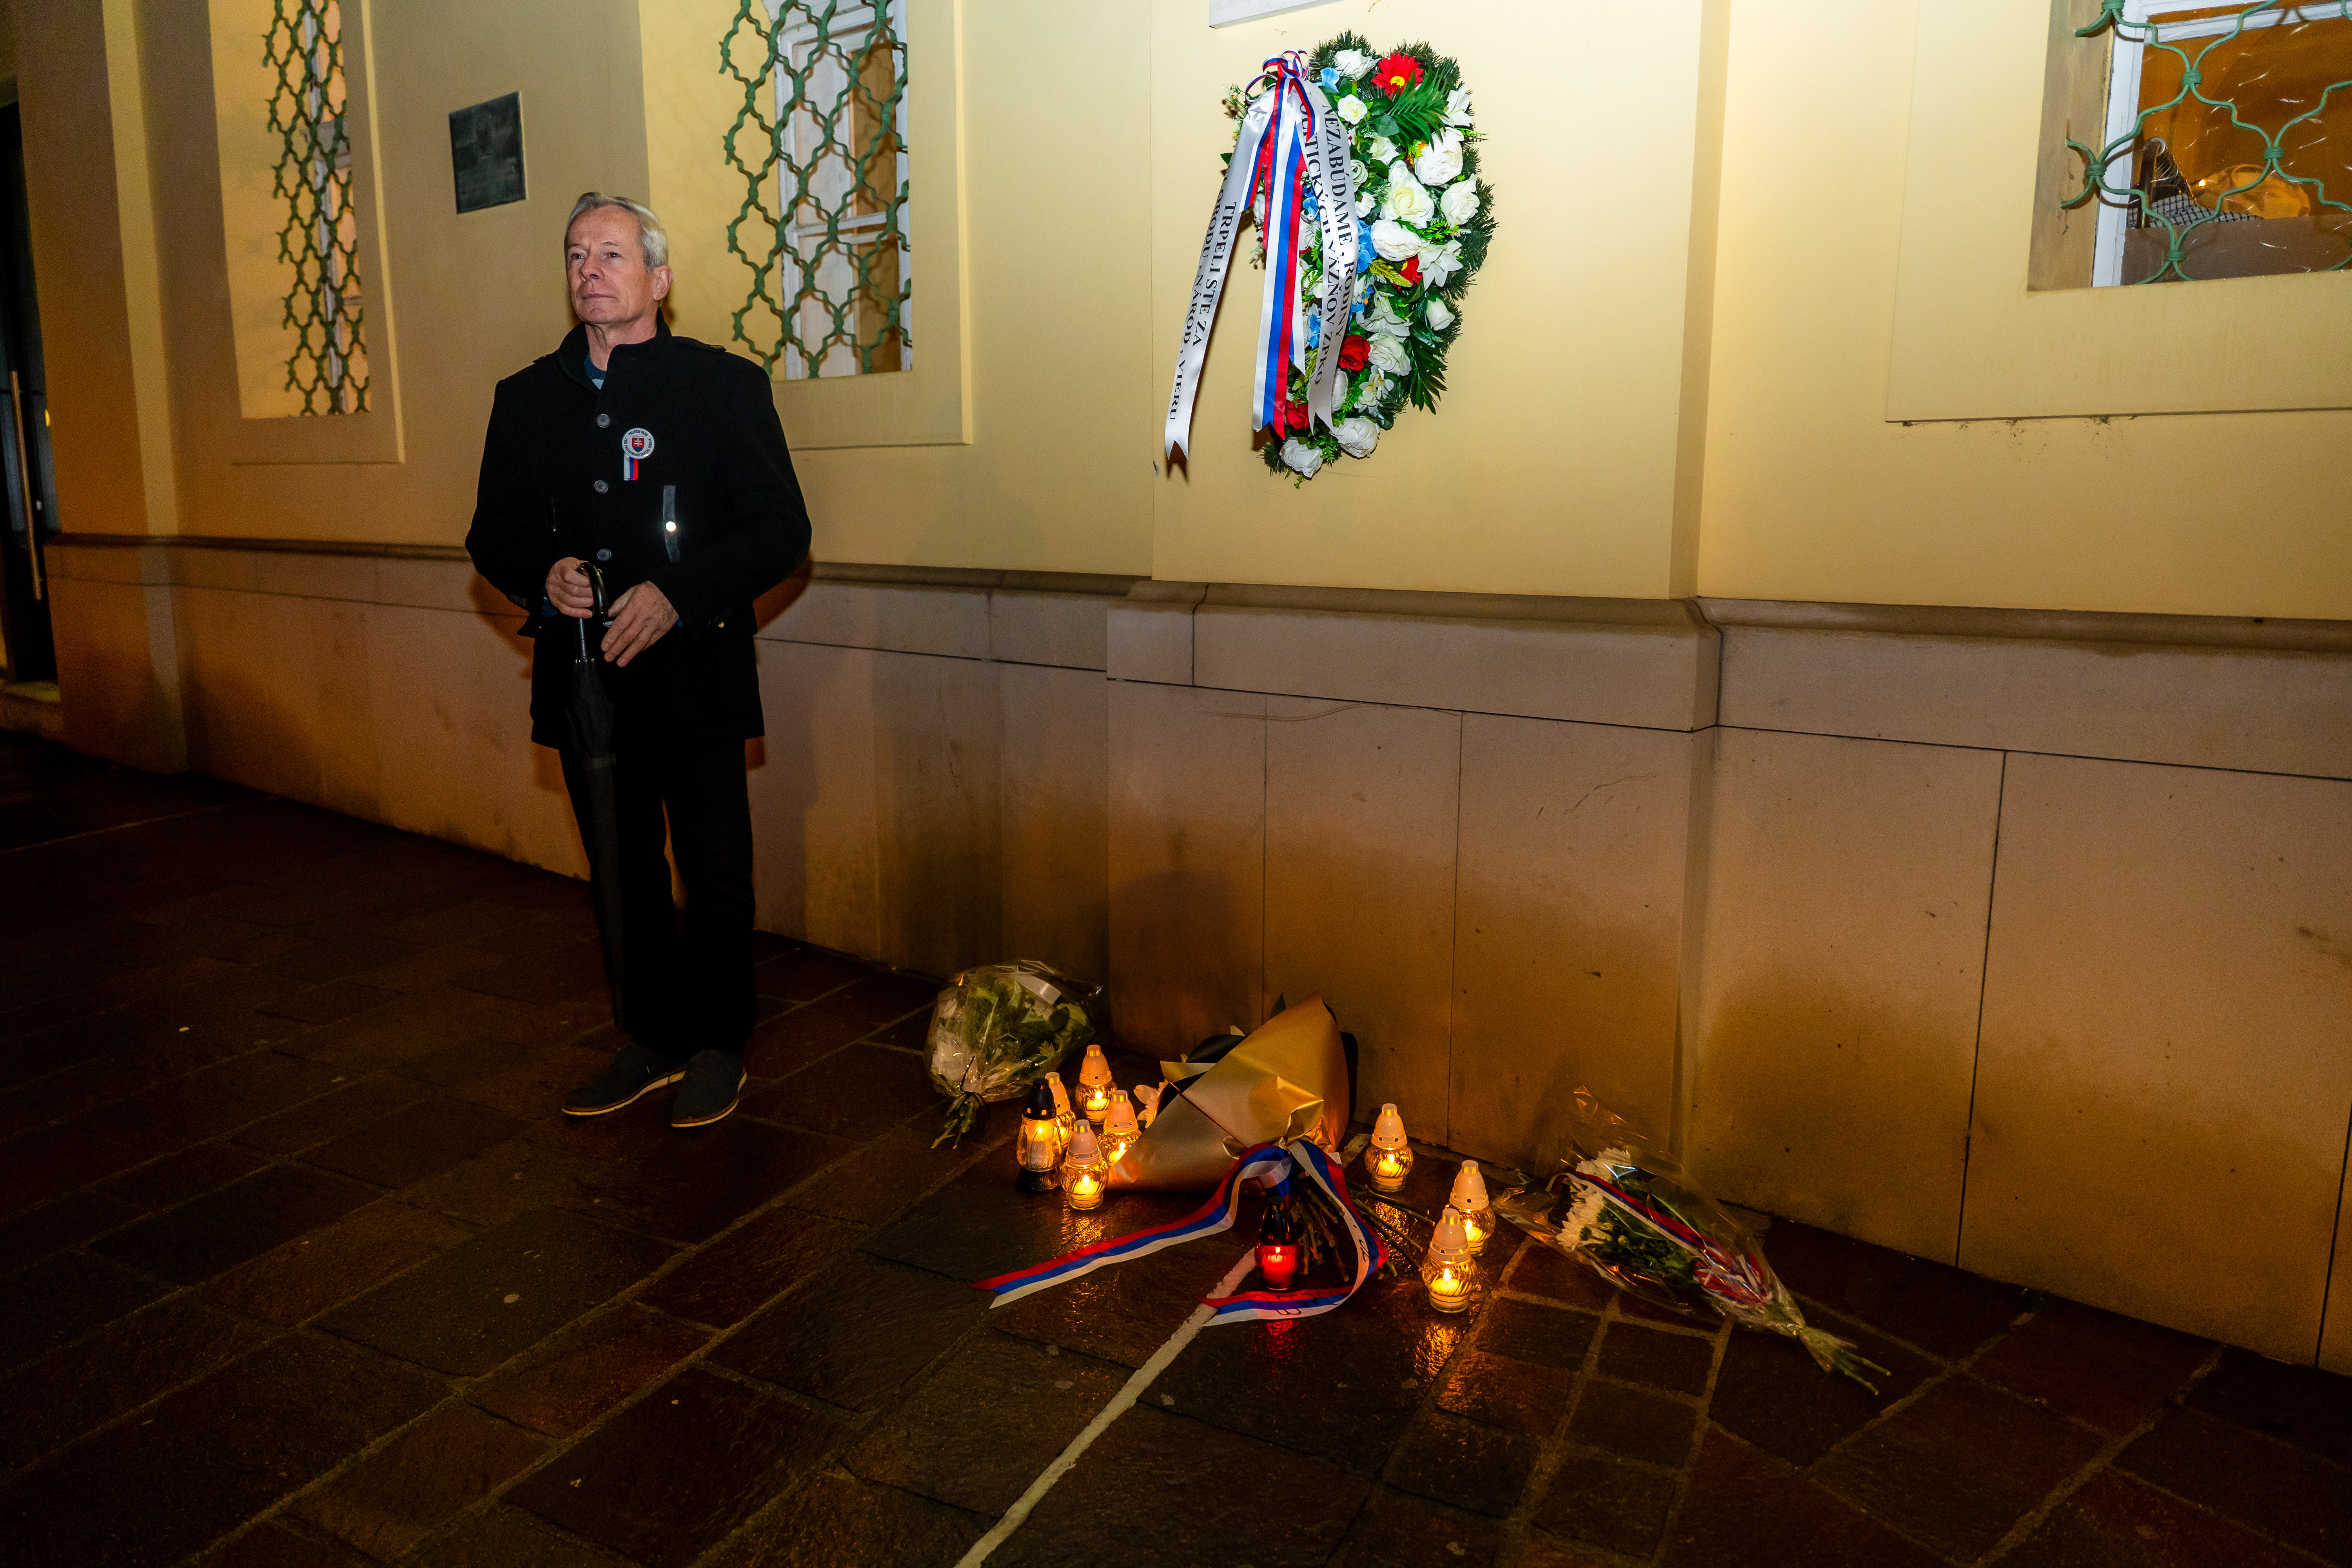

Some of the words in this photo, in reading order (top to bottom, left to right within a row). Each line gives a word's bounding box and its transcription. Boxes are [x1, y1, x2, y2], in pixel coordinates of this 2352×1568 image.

[1300, 93, 1330, 234] OLTICKÝCH
[1322, 105, 1352, 245] NEZABÚDAME
[1209, 201, 1237, 273] TRPELI
[1183, 273, 1203, 344] NÁROD
[1200, 278, 1218, 315] STE
[1325, 240, 1343, 325] VÄZŇOV
[1335, 259, 1355, 337] RODINY
[1192, 321, 1207, 347] ZA
[1315, 331, 1332, 385] ZPKO
[1169, 359, 1185, 420] VIERU
